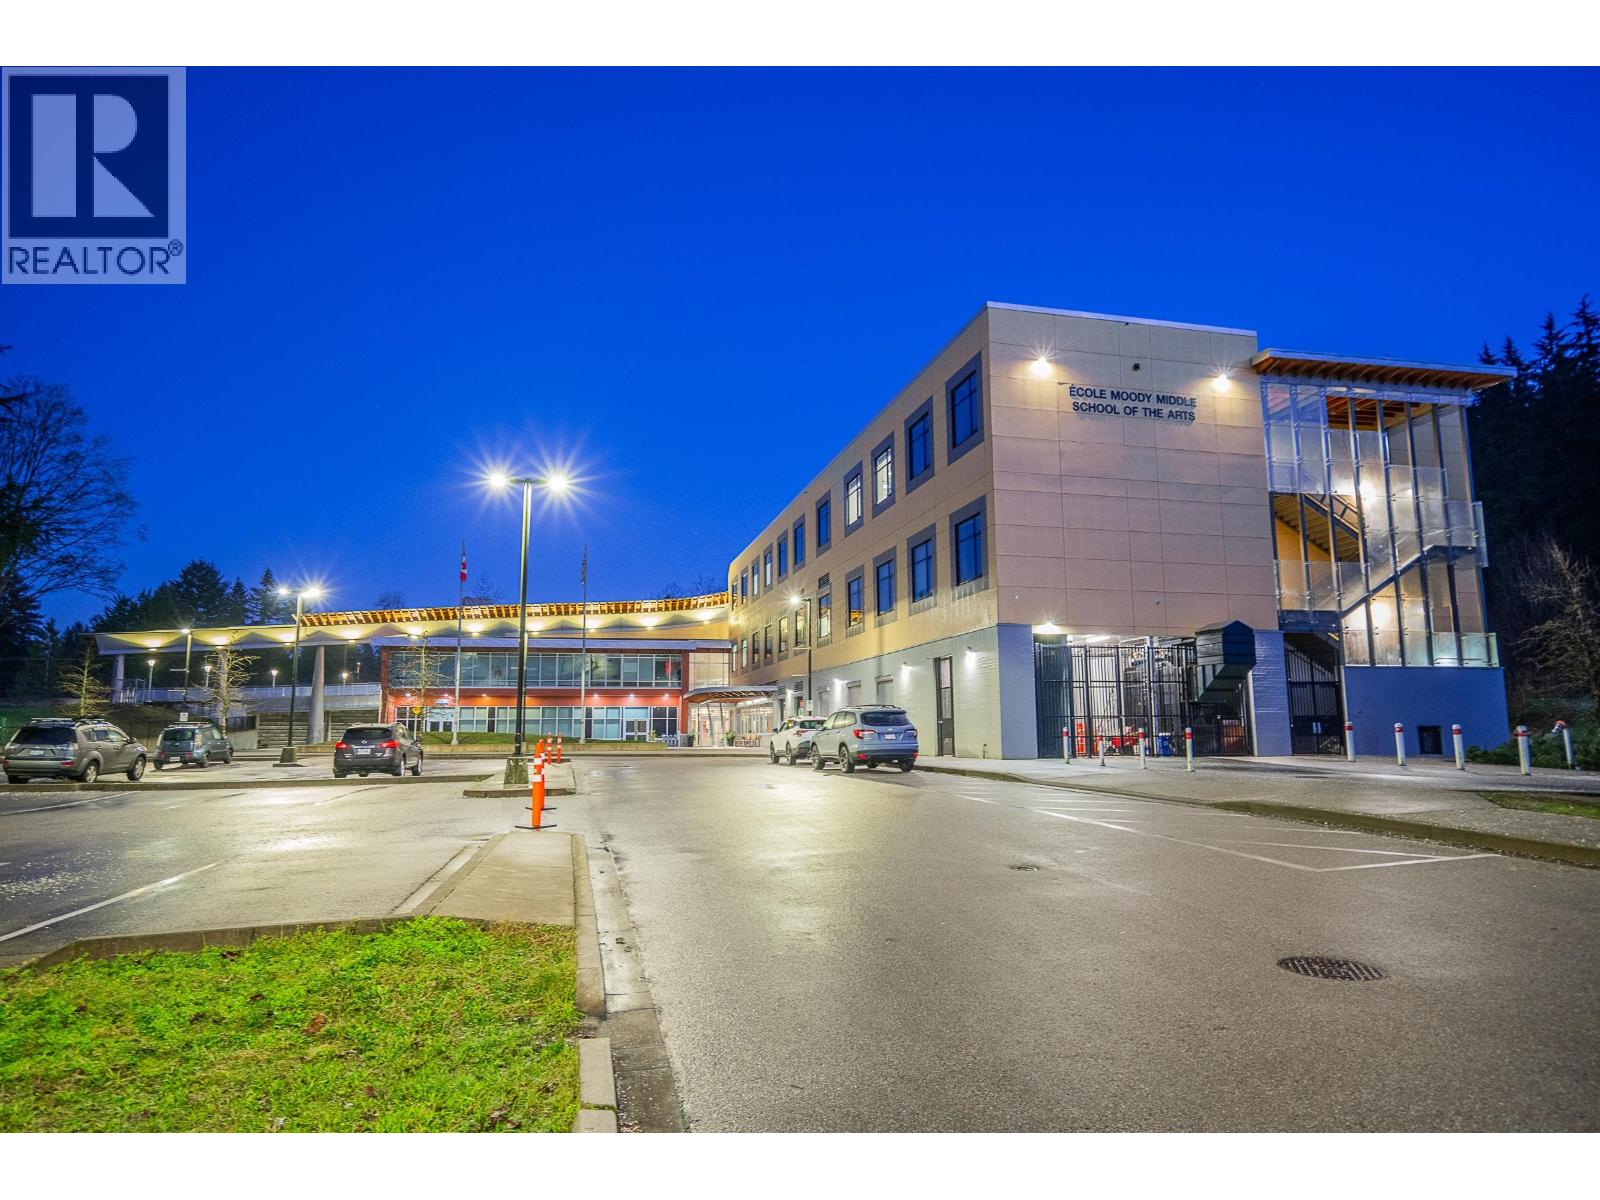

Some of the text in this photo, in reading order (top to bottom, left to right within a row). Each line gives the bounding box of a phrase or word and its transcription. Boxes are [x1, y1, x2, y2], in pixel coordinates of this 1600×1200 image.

[1069, 383, 1197, 407] ÉCOLE MOODY MIDDLE
[1072, 401, 1196, 422] SCHOOL OF THE ARTS
